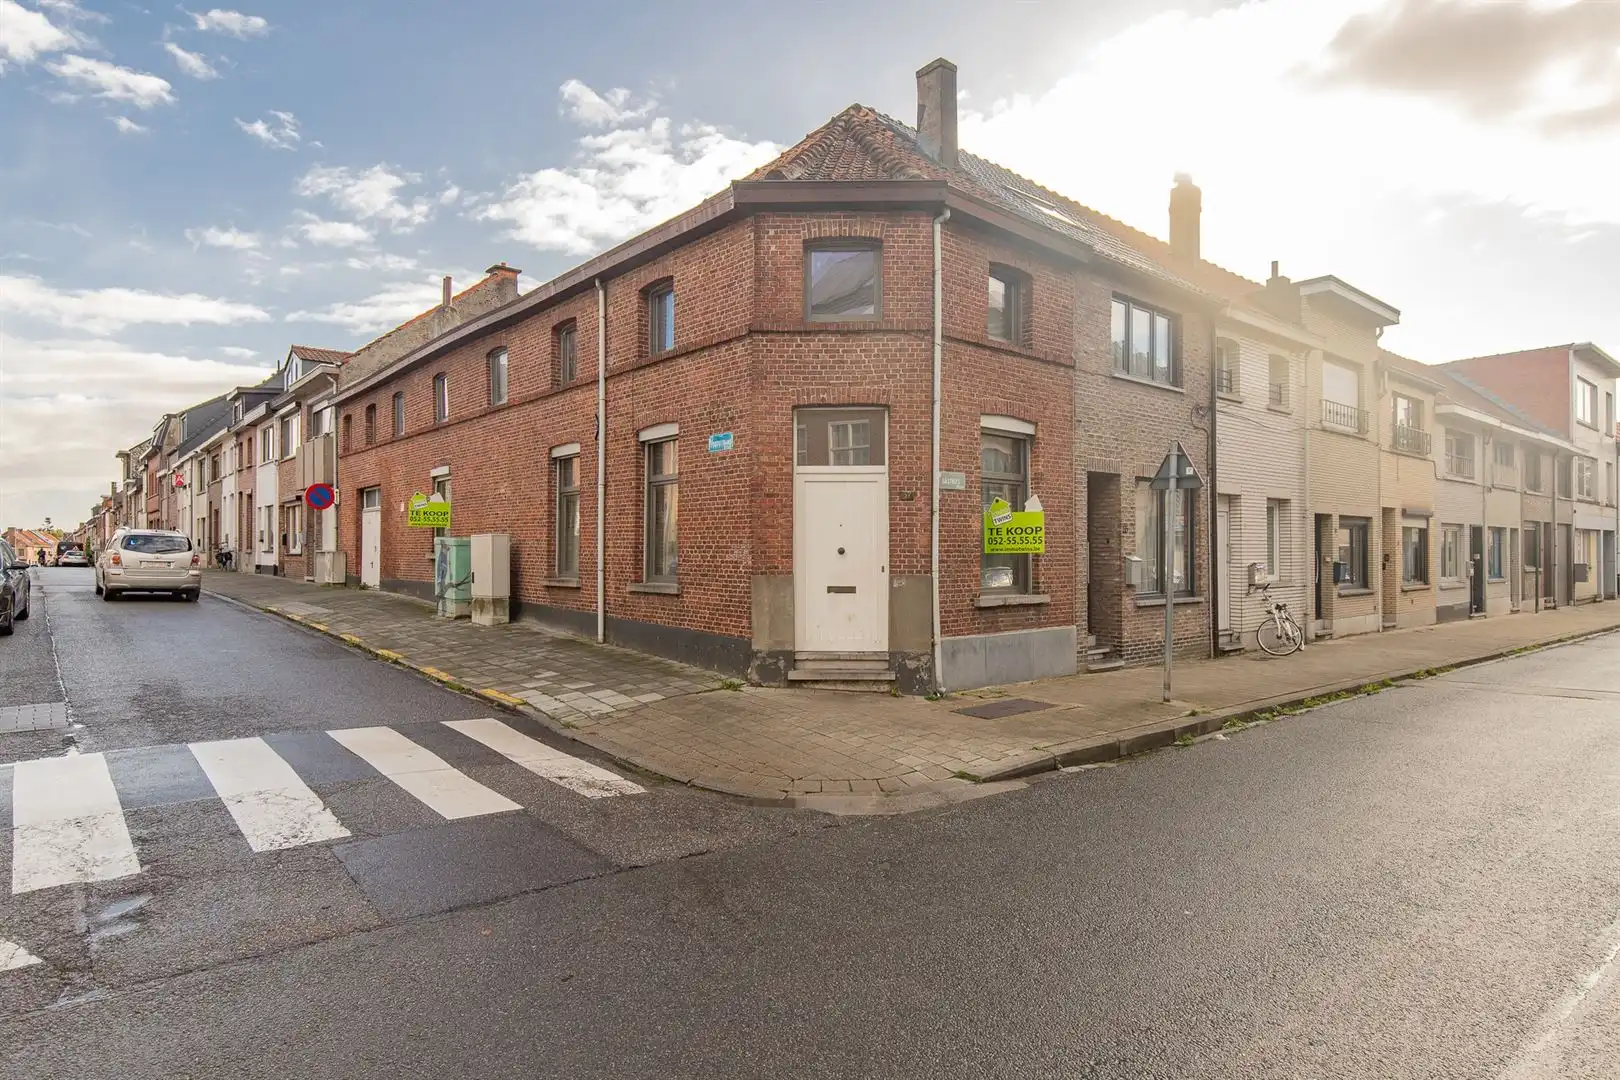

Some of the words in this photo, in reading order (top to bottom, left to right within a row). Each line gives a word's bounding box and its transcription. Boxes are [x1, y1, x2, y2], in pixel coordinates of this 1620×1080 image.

[993, 513, 1012, 524] TWINS
[988, 527, 1003, 536] TE
[1006, 526, 1043, 536] KOOP
[987, 536, 1043, 545] 052-55.55.55
